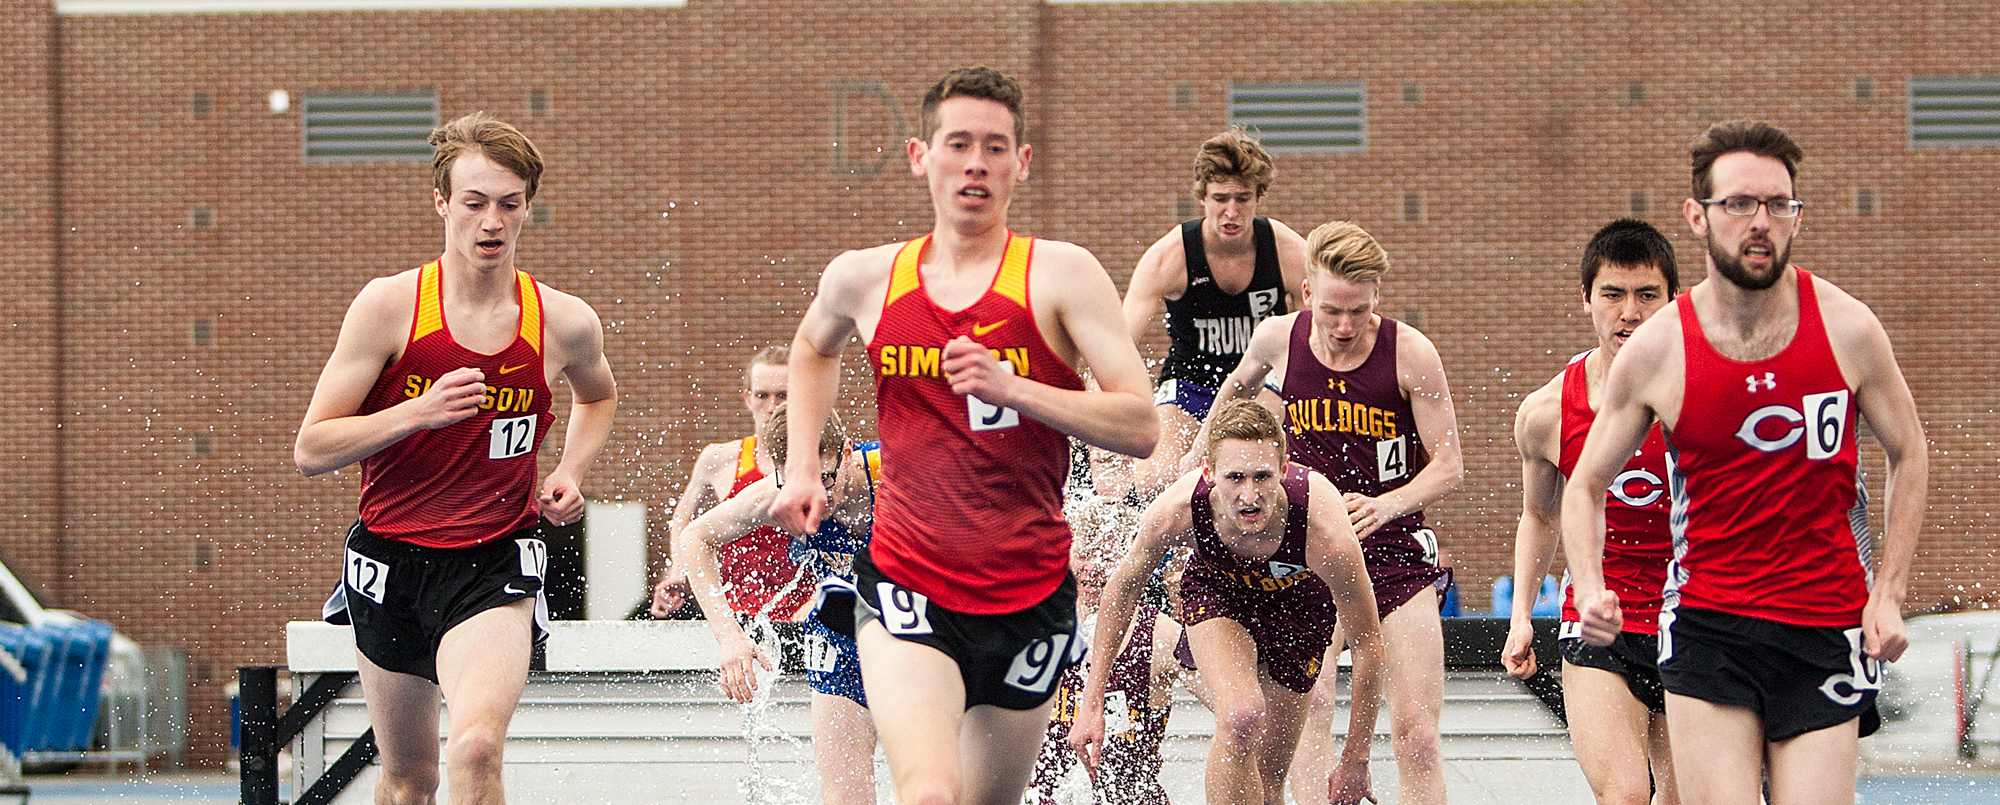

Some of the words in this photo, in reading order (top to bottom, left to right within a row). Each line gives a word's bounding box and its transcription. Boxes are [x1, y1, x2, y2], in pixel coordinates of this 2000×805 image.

[1256, 292, 1271, 315] 3
[1194, 311, 1275, 354] TRUM
[881, 345, 1030, 377] SIMN
[404, 374, 534, 412] SISON
[501, 418, 530, 456] 12
[1288, 399, 1397, 438] BULLDOGS
[1735, 404, 1805, 452] C
[1817, 397, 1839, 453] 6
[1385, 441, 1403, 475] 4
[1608, 469, 1664, 507] C
[353, 557, 378, 598] 12
[891, 587, 920, 629] 9
[1018, 636, 1055, 686] 9
